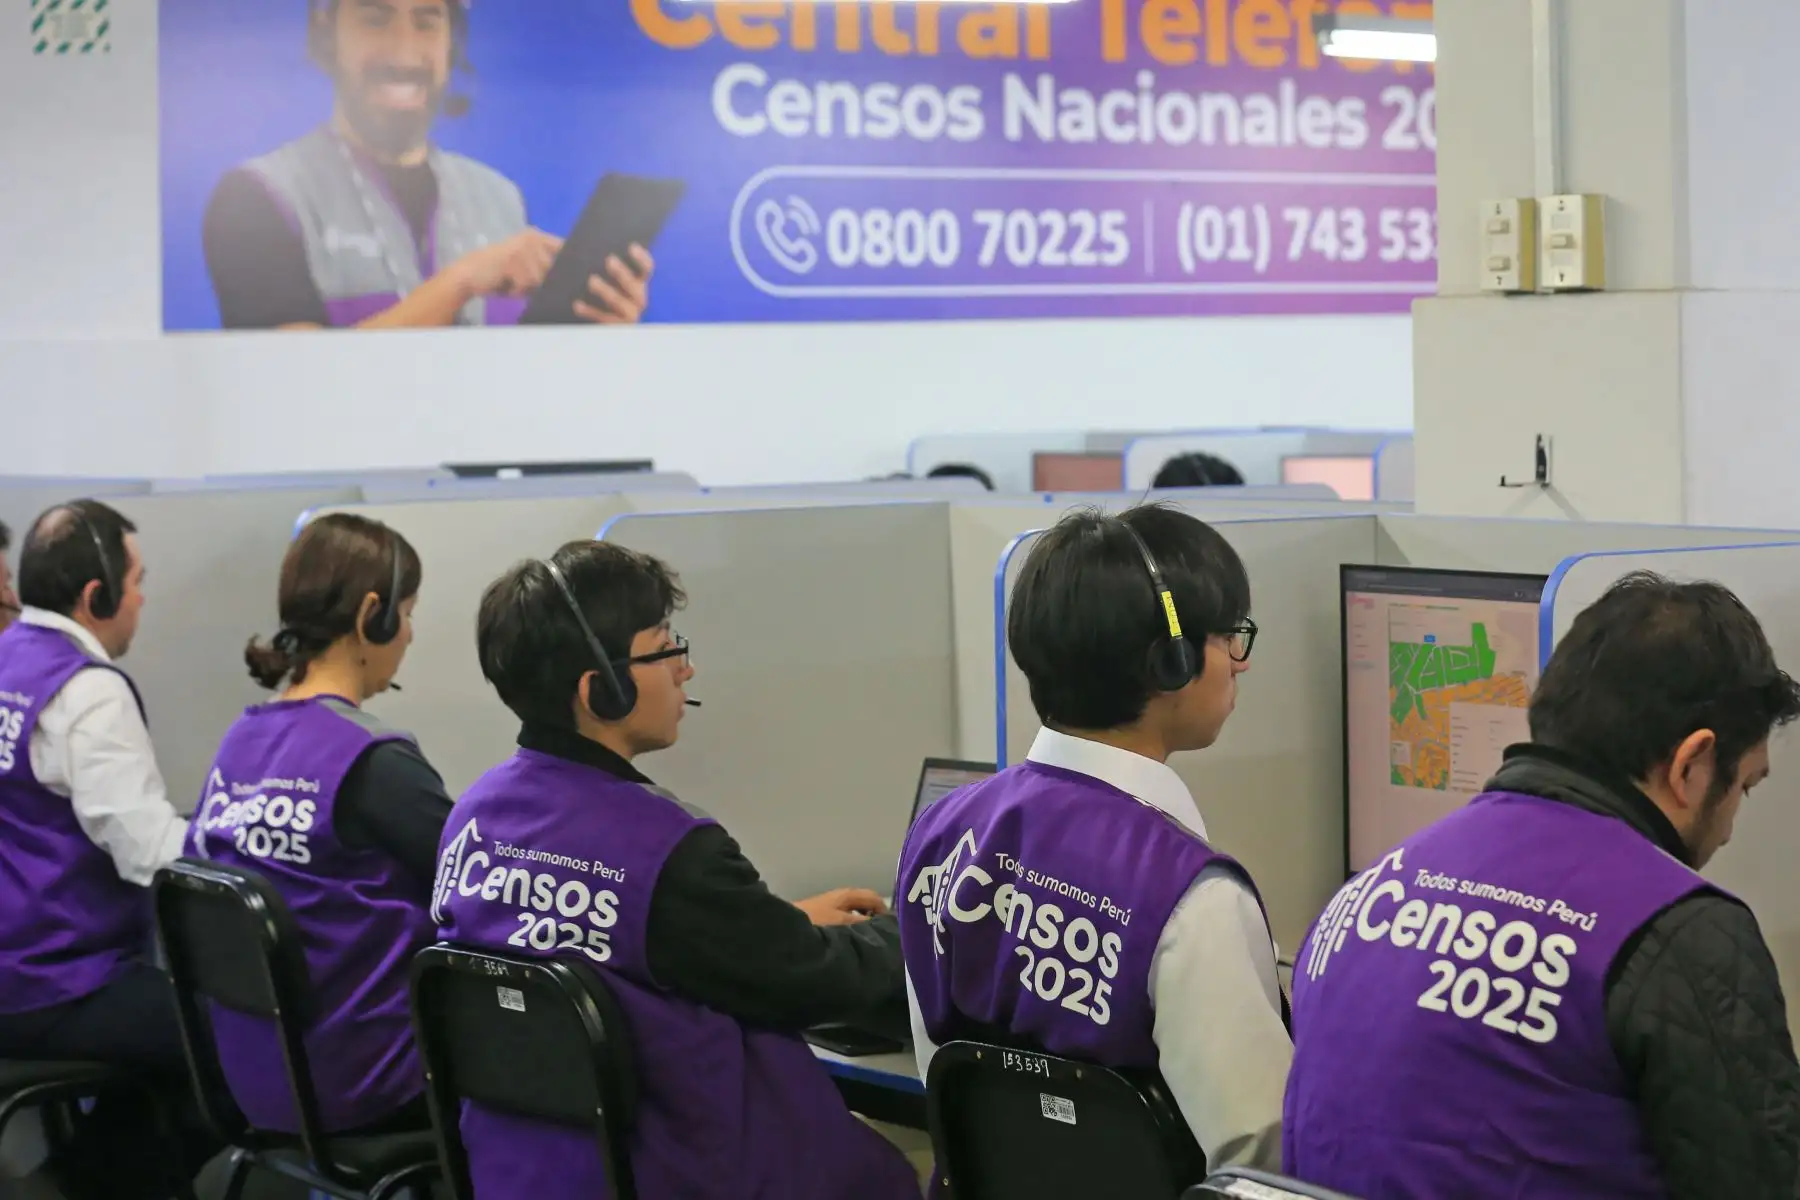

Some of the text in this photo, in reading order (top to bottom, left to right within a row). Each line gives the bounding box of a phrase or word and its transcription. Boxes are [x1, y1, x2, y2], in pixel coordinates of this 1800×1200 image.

[712, 62, 985, 141] Censos
[1003, 70, 1369, 149] Nacionales
[826, 206, 1130, 268] 0800 70225
[1177, 200, 1437, 275] (01) 743 53
[232, 826, 312, 865] 2025
[494, 841, 626, 884] Todos sumamos Perú
[458, 850, 620, 929] Censos
[947, 863, 1123, 980] Censos
[1026, 869, 1097, 909] sumamos
[1099, 896, 1132, 927] Perú
[1413, 868, 1599, 933] Todos sumamos Perú
[507, 911, 613, 963] 2025
[1356, 878, 1578, 988] Censos
[1013, 945, 1114, 1026] 2025
[1416, 959, 1562, 1044] 2025
